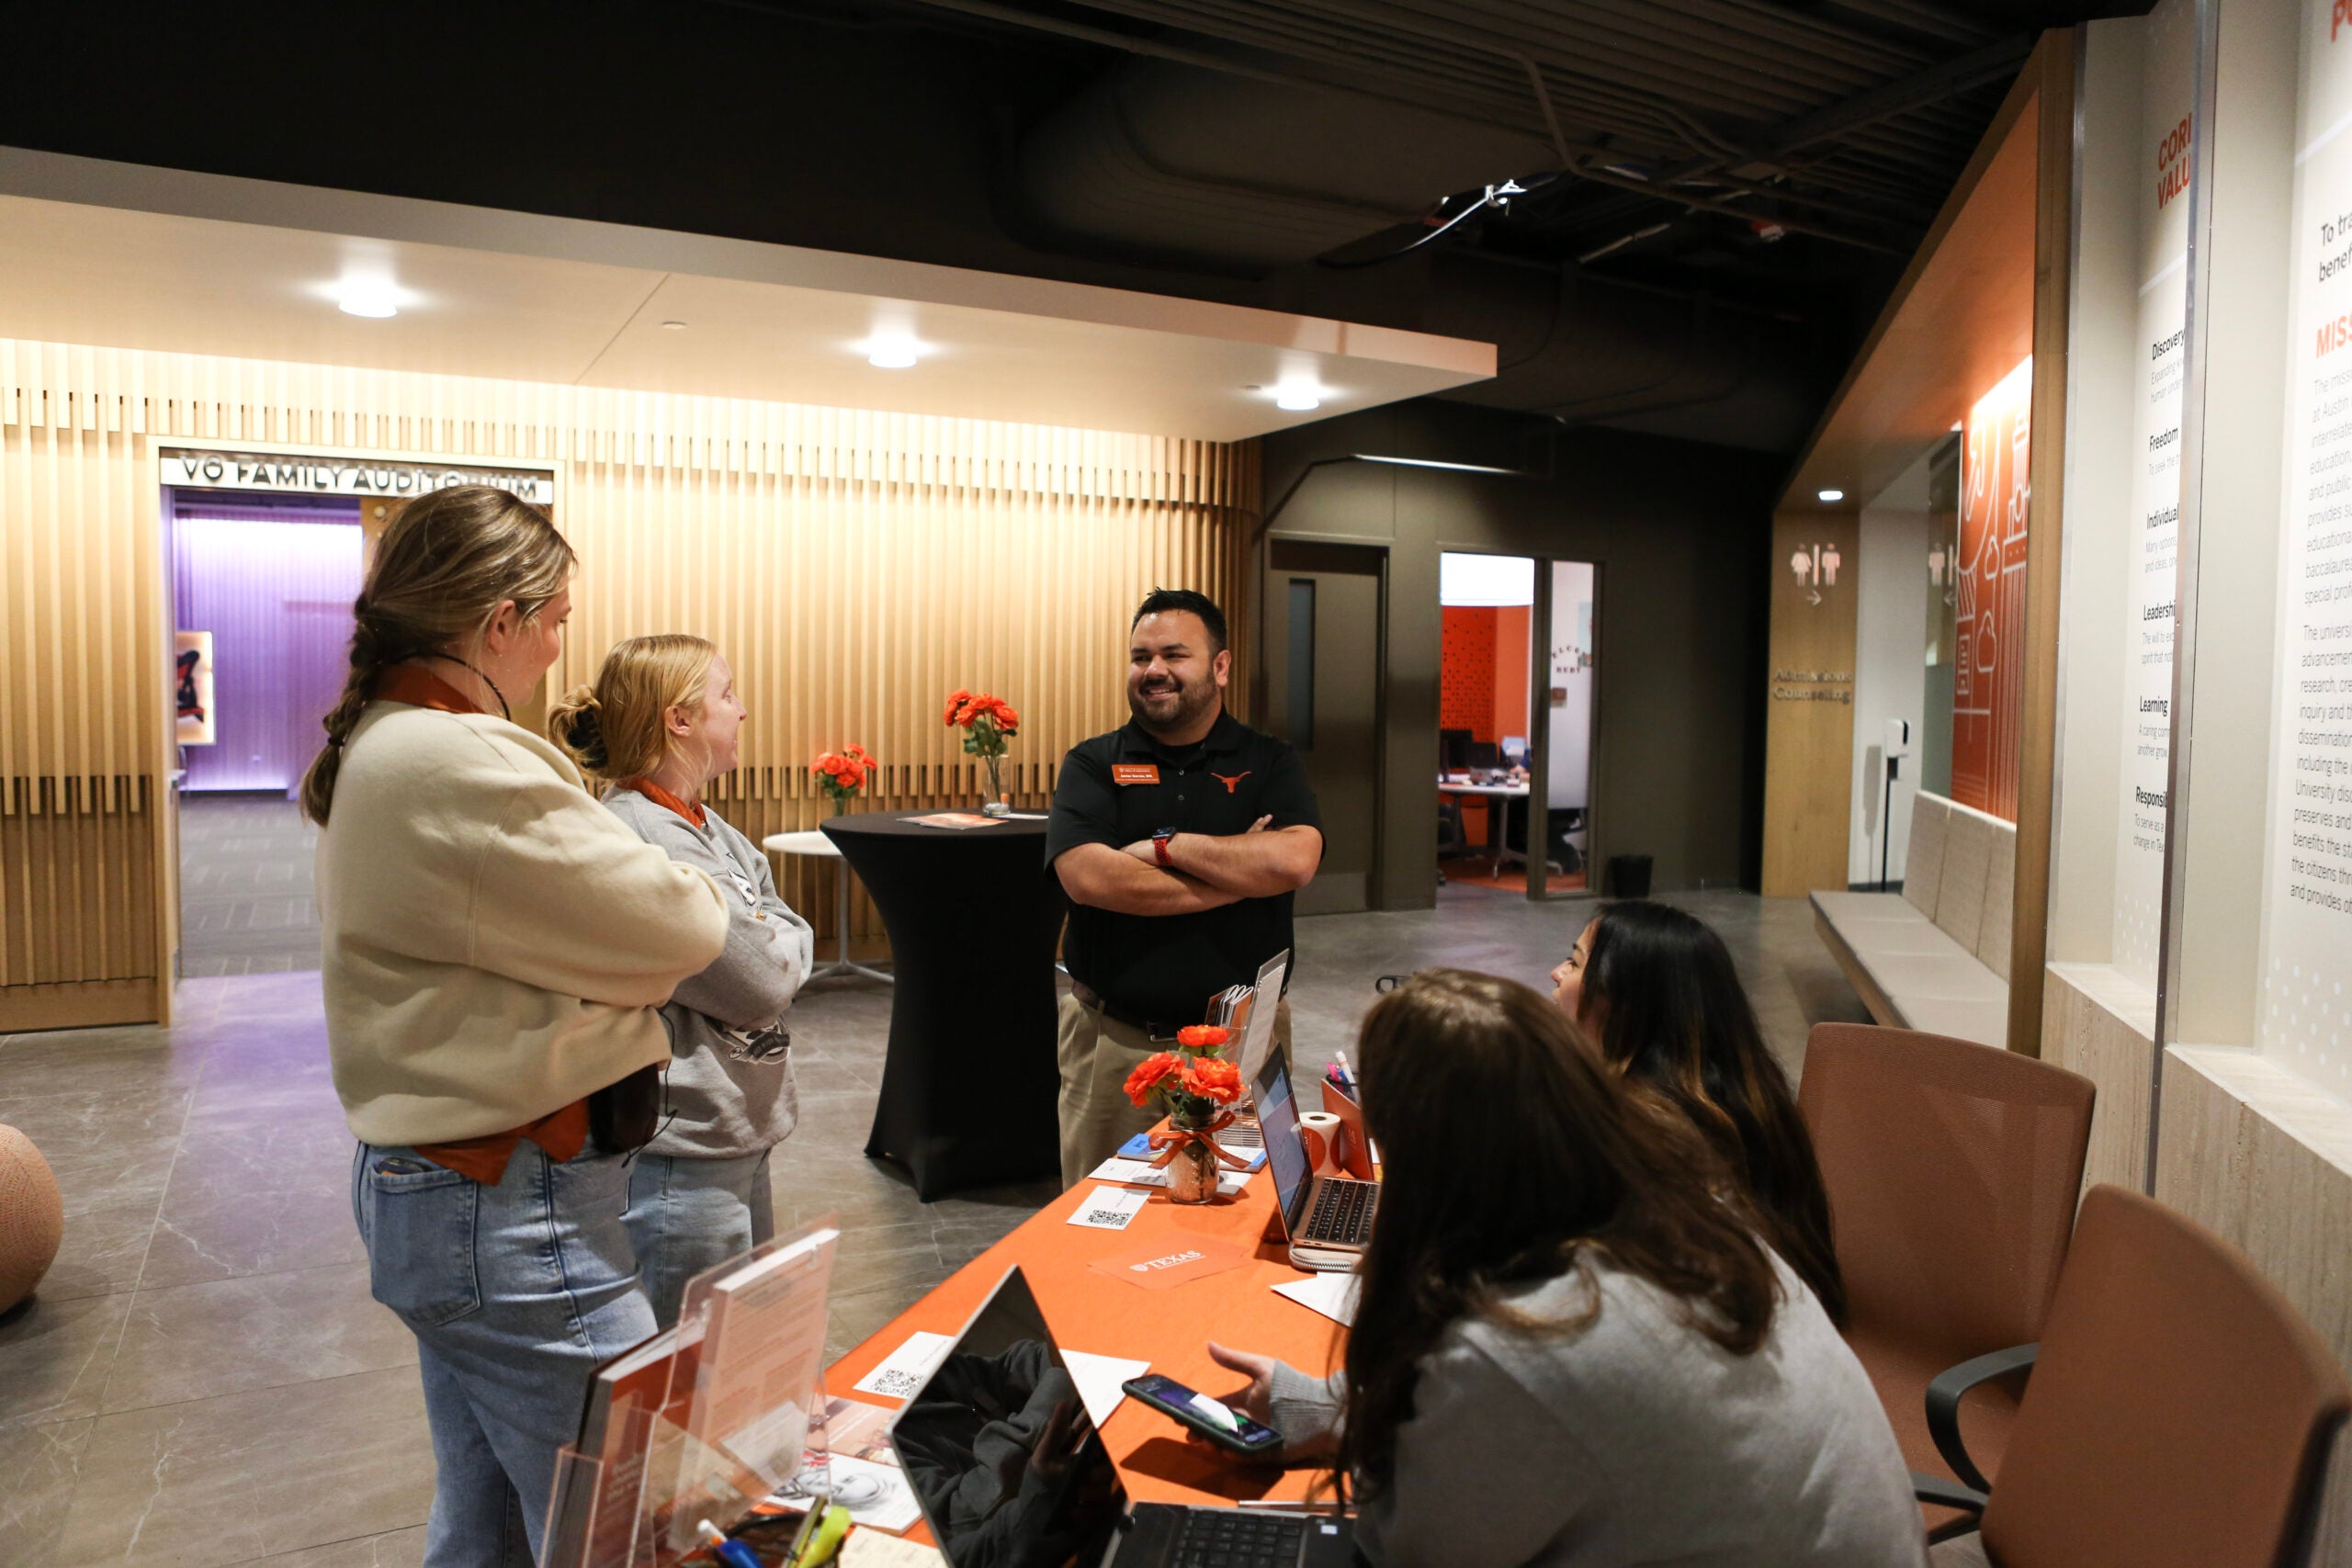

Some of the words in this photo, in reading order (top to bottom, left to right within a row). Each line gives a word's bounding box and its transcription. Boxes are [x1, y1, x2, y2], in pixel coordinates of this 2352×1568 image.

[2321, 223, 2335, 246] To
[2152, 327, 2186, 361] Discovery
[2149, 427, 2178, 453] Freedom
[178, 451, 224, 483] VO
[235, 455, 348, 490] FAMILY
[2308, 504, 2342, 531] provides
[2304, 585, 2332, 607] special
[2303, 625, 2318, 641] The
[1774, 668, 1853, 683] Admissions
[1773, 687, 1852, 705] Counseling
[2140, 695, 2168, 717] Learning
[2299, 702, 2326, 724] inquiry
[2328, 704, 2344, 720] and
[2296, 753, 2332, 777] including
[2335, 757, 2348, 774] the
[2296, 778, 2336, 805] University
[2294, 808, 2334, 828] preserves
[2335, 812, 2352, 830] and
[2293, 830, 2324, 852] benefits
[2326, 837, 2341, 856] the
[2291, 855, 2305, 874] the
[2306, 860, 2336, 883] citizens
[2290, 883, 2305, 900] and
[2307, 888, 2343, 911] provides
[1146, 1249, 1202, 1269] TEXAS
